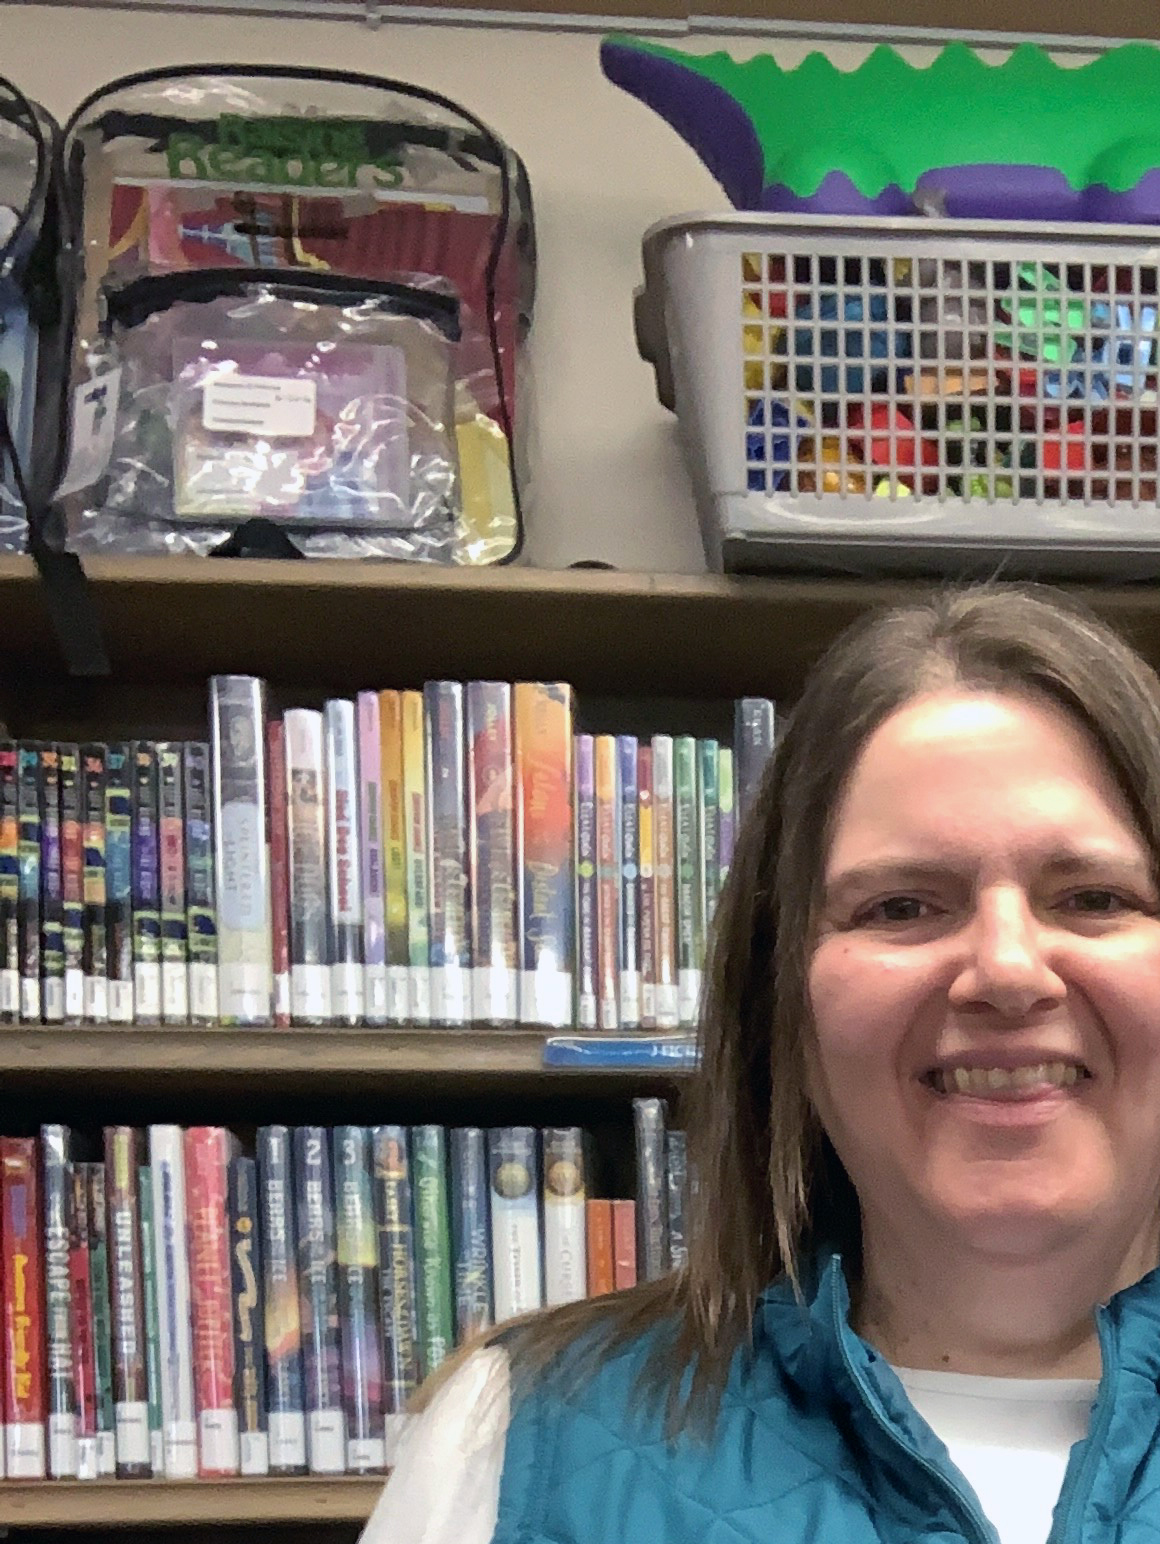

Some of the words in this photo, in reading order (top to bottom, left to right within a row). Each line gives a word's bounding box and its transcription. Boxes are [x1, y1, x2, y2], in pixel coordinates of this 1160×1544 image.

[306, 1138, 322, 1166] 2
[342, 1138, 357, 1166] 3
[114, 1210, 135, 1355] UNLEASHED
[470, 1228, 491, 1314] WRINKLE
